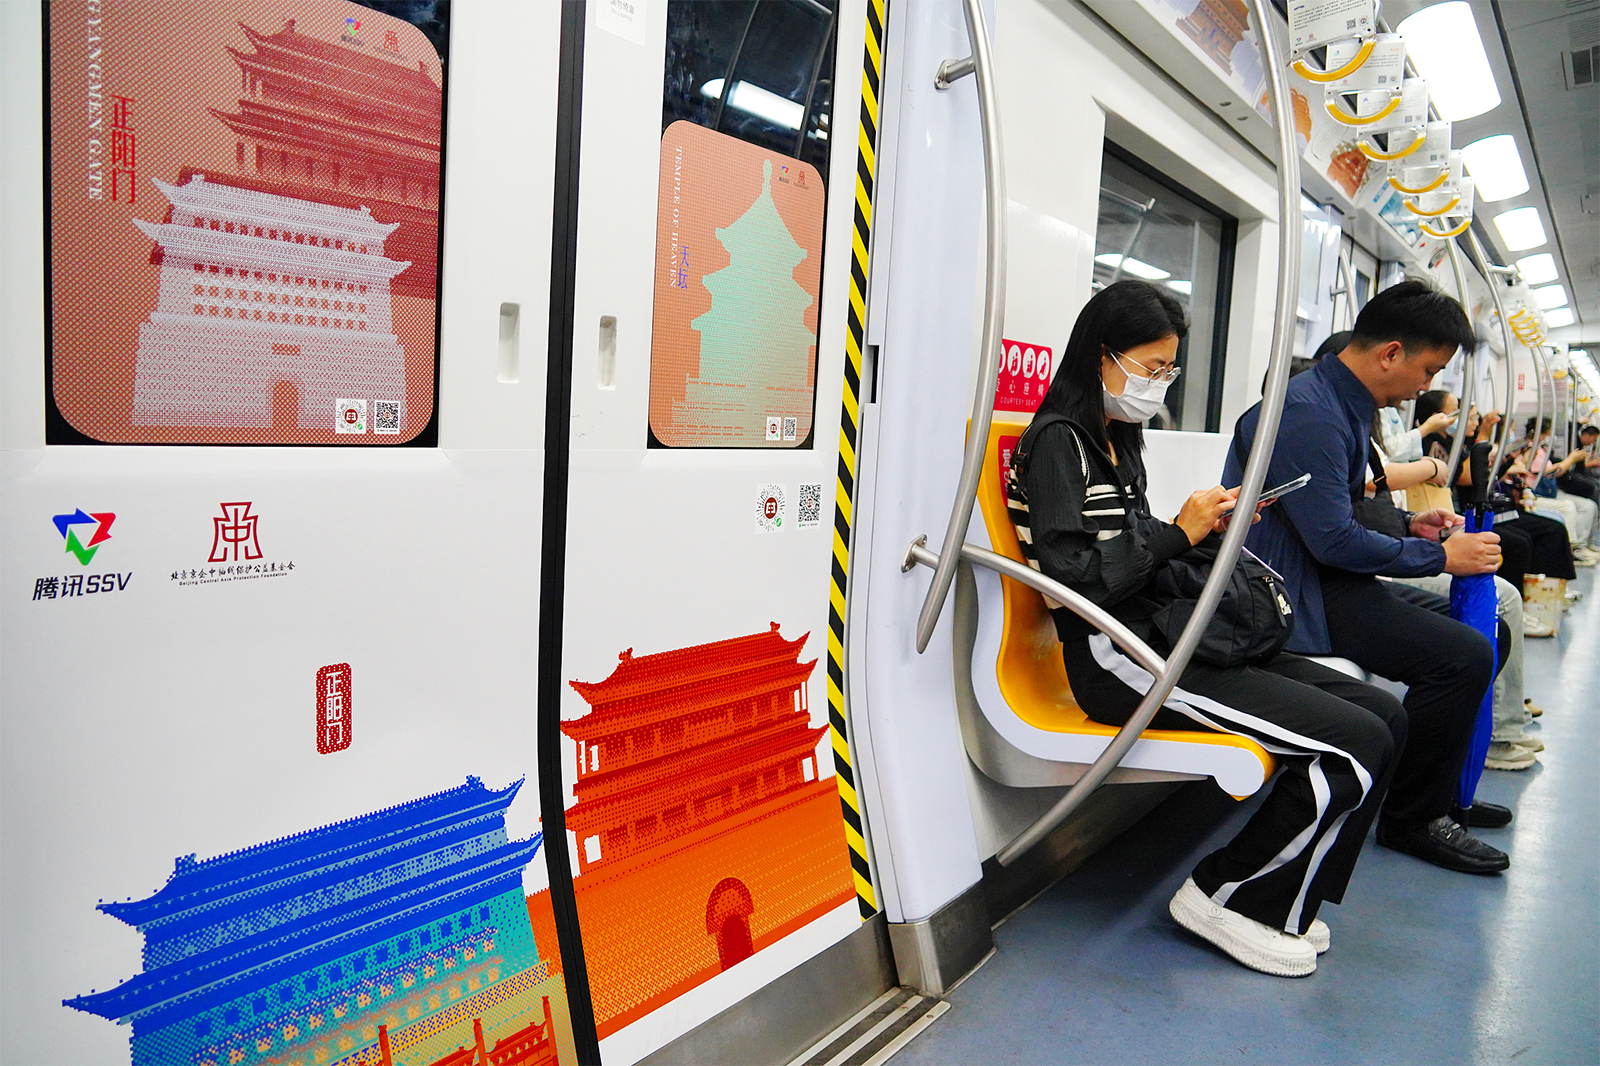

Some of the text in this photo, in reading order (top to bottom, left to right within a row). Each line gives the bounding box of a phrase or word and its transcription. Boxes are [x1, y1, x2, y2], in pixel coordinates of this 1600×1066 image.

[88, 139, 103, 200] GATE
[111, 95, 136, 204] 正阳门
[670, 146, 683, 288] TEMPLE OF HEAVEN
[678, 245, 690, 289] 天坛
[1000, 396, 1037, 406] COURTESY SEAT
[32, 571, 133, 601] 腾讯SSV
[326, 671, 344, 747] 正阳门
